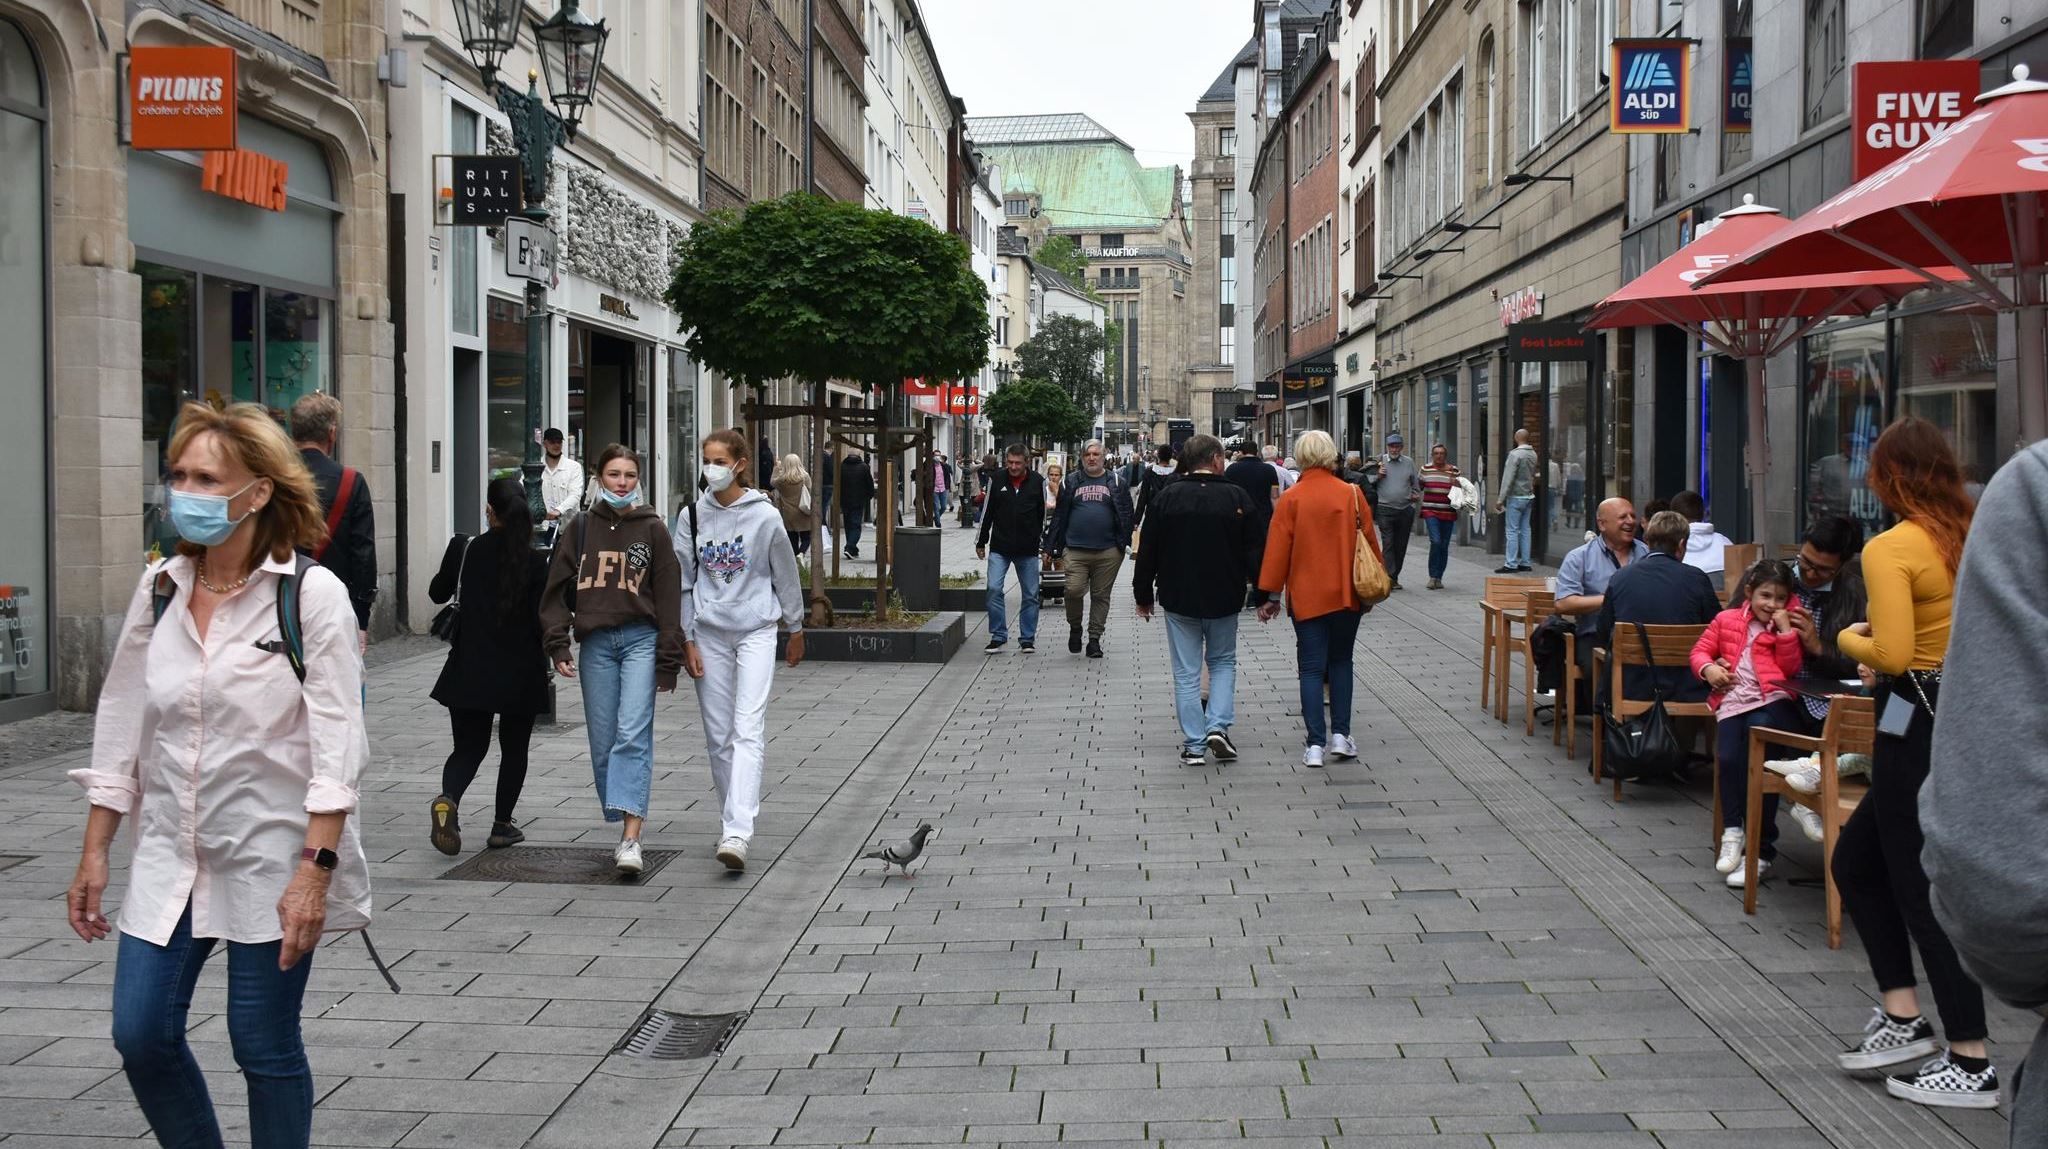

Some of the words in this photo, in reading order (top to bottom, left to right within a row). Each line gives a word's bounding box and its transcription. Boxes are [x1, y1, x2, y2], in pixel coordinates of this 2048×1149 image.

[138, 77, 224, 101] PYLONES
[1624, 92, 1676, 109] ALDI
[1877, 92, 1961, 119] FIVE
[138, 104, 180, 116] créateur
[183, 104, 224, 118] d'objets
[1640, 109, 1660, 120] SÜD
[1866, 122, 1951, 149] GUY
[1304, 365, 1332, 374] DOUGLAS
